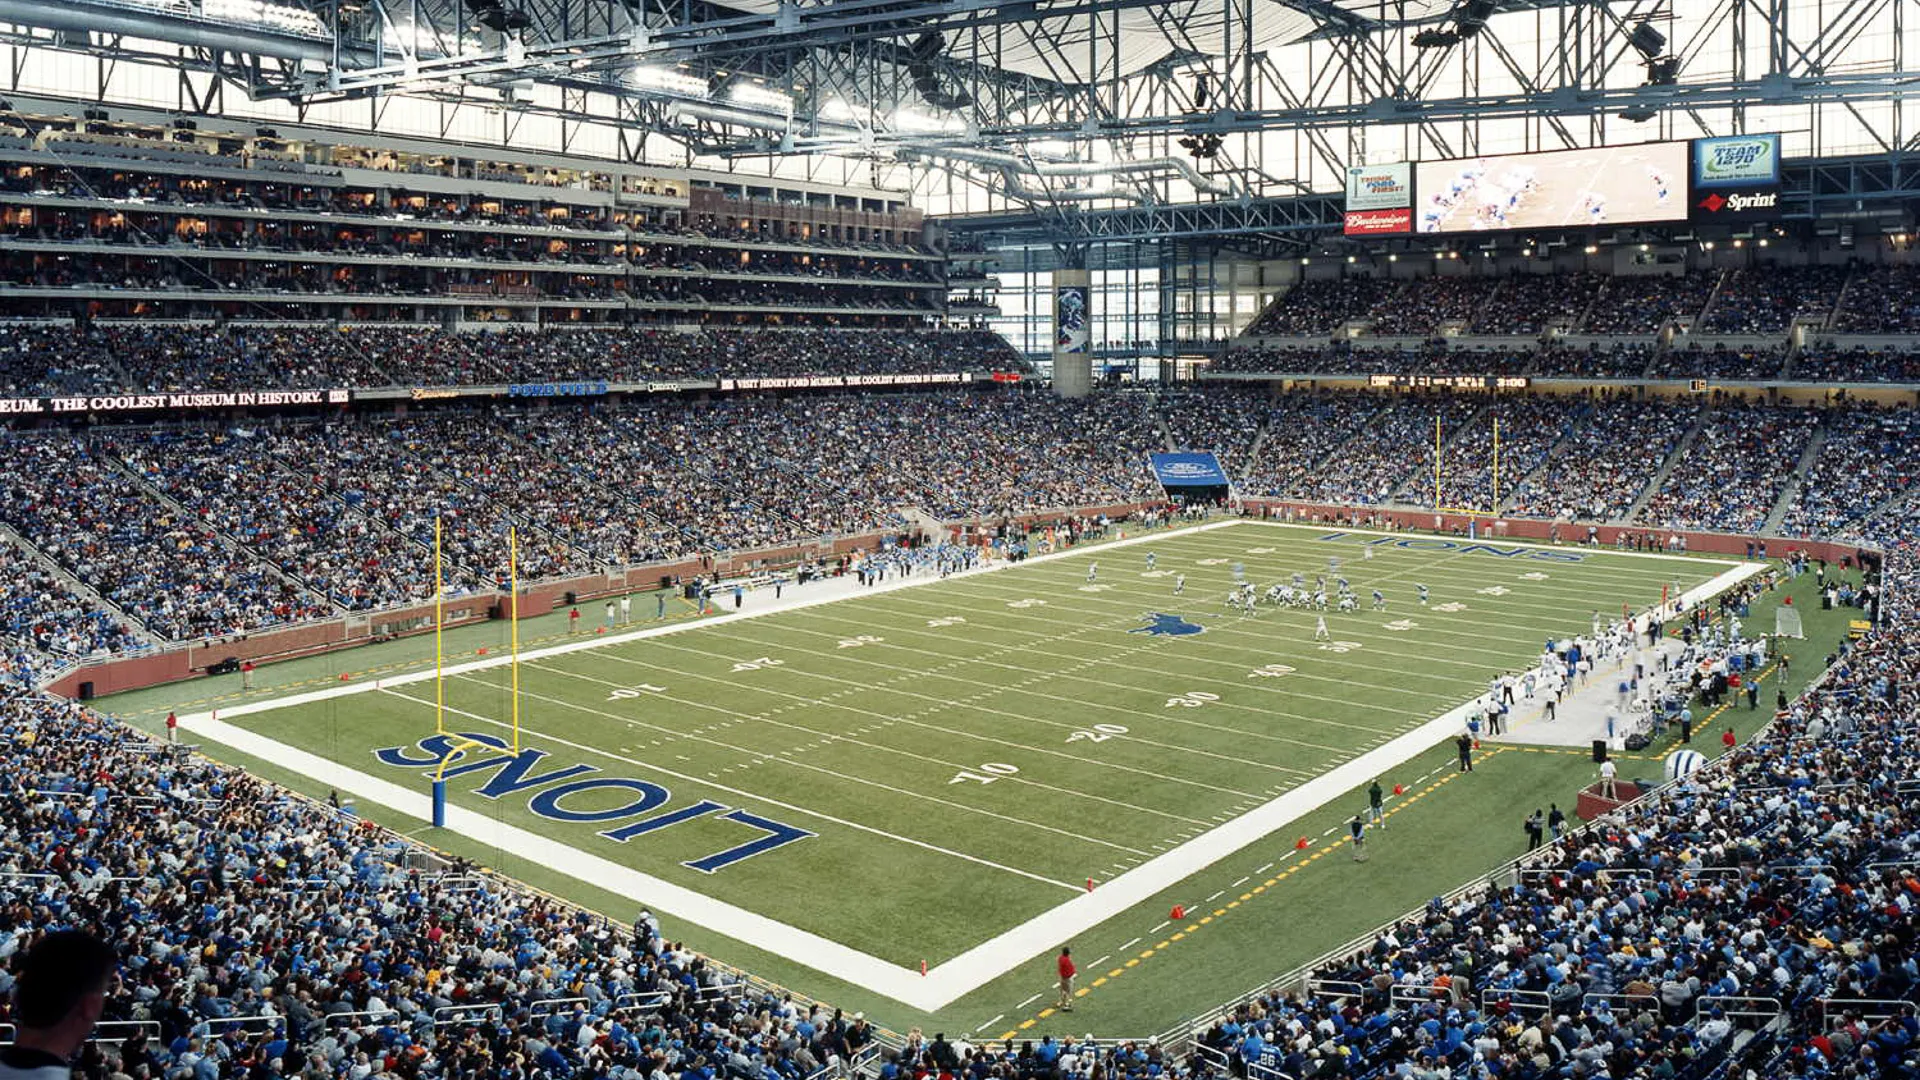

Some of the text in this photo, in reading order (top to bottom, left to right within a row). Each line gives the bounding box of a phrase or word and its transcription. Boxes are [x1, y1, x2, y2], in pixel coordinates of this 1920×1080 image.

[1714, 145, 1761, 157] TEAM
[1727, 193, 1776, 211] Sprint
[1345, 214, 1409, 228] Budweiser
[508, 380, 609, 397] FORD FIELD
[51, 397, 89, 412] THE
[90, 395, 168, 411] COOLEST
[169, 393, 237, 408] MUSEUM
[238, 392, 257, 406] IN
[258, 390, 324, 405] HISTORY.
[1314, 532, 1593, 563] LIONS
[1068, 723, 1130, 743] 20
[955, 763, 1020, 785] 10
[373, 733, 818, 873] LIONS
